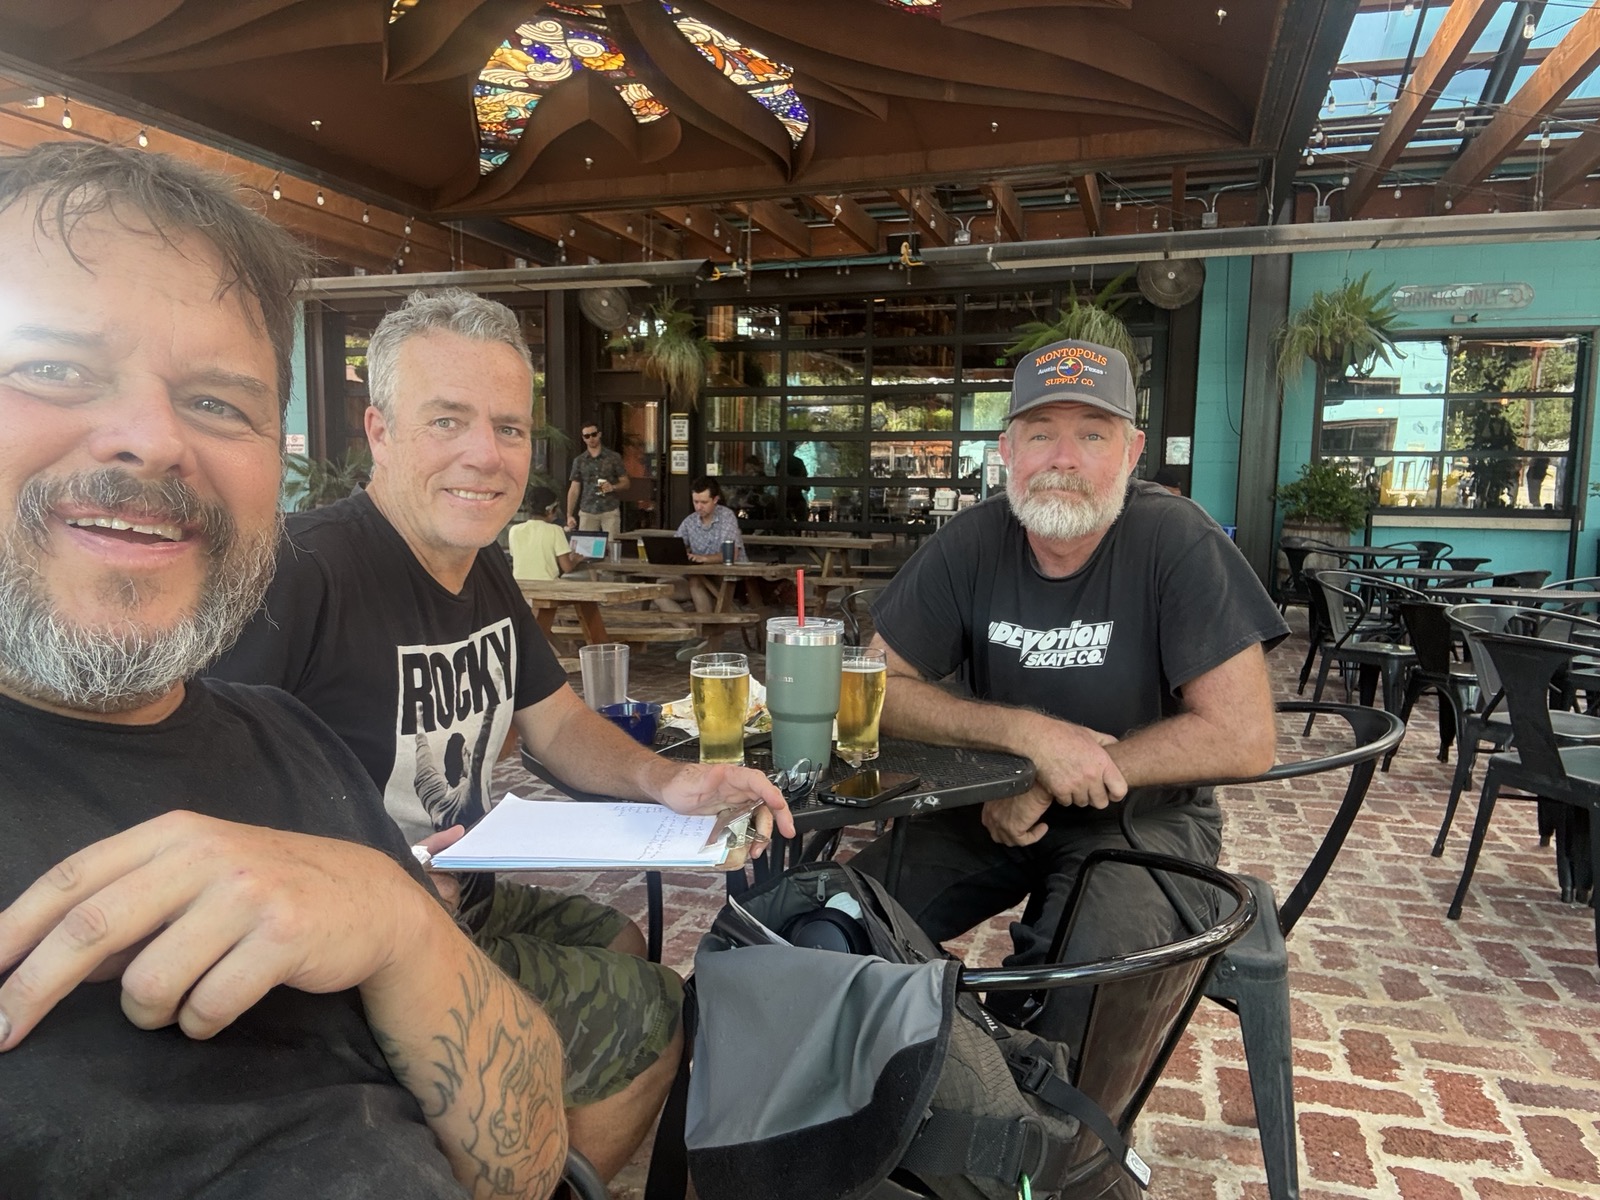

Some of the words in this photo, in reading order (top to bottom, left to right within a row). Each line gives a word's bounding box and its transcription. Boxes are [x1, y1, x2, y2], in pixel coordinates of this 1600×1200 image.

[1402, 289, 1457, 308] DRINKS
[1463, 288, 1501, 306] ONLY
[1036, 347, 1107, 367] MONTOPOLIS
[1083, 365, 1104, 375] Texas
[1045, 377, 1079, 387] SUPPLY
[1080, 377, 1096, 388] CO.
[1025, 652, 1076, 667] SKATE
[1077, 649, 1103, 665] CO.
[401, 624, 514, 736] ROCKY
